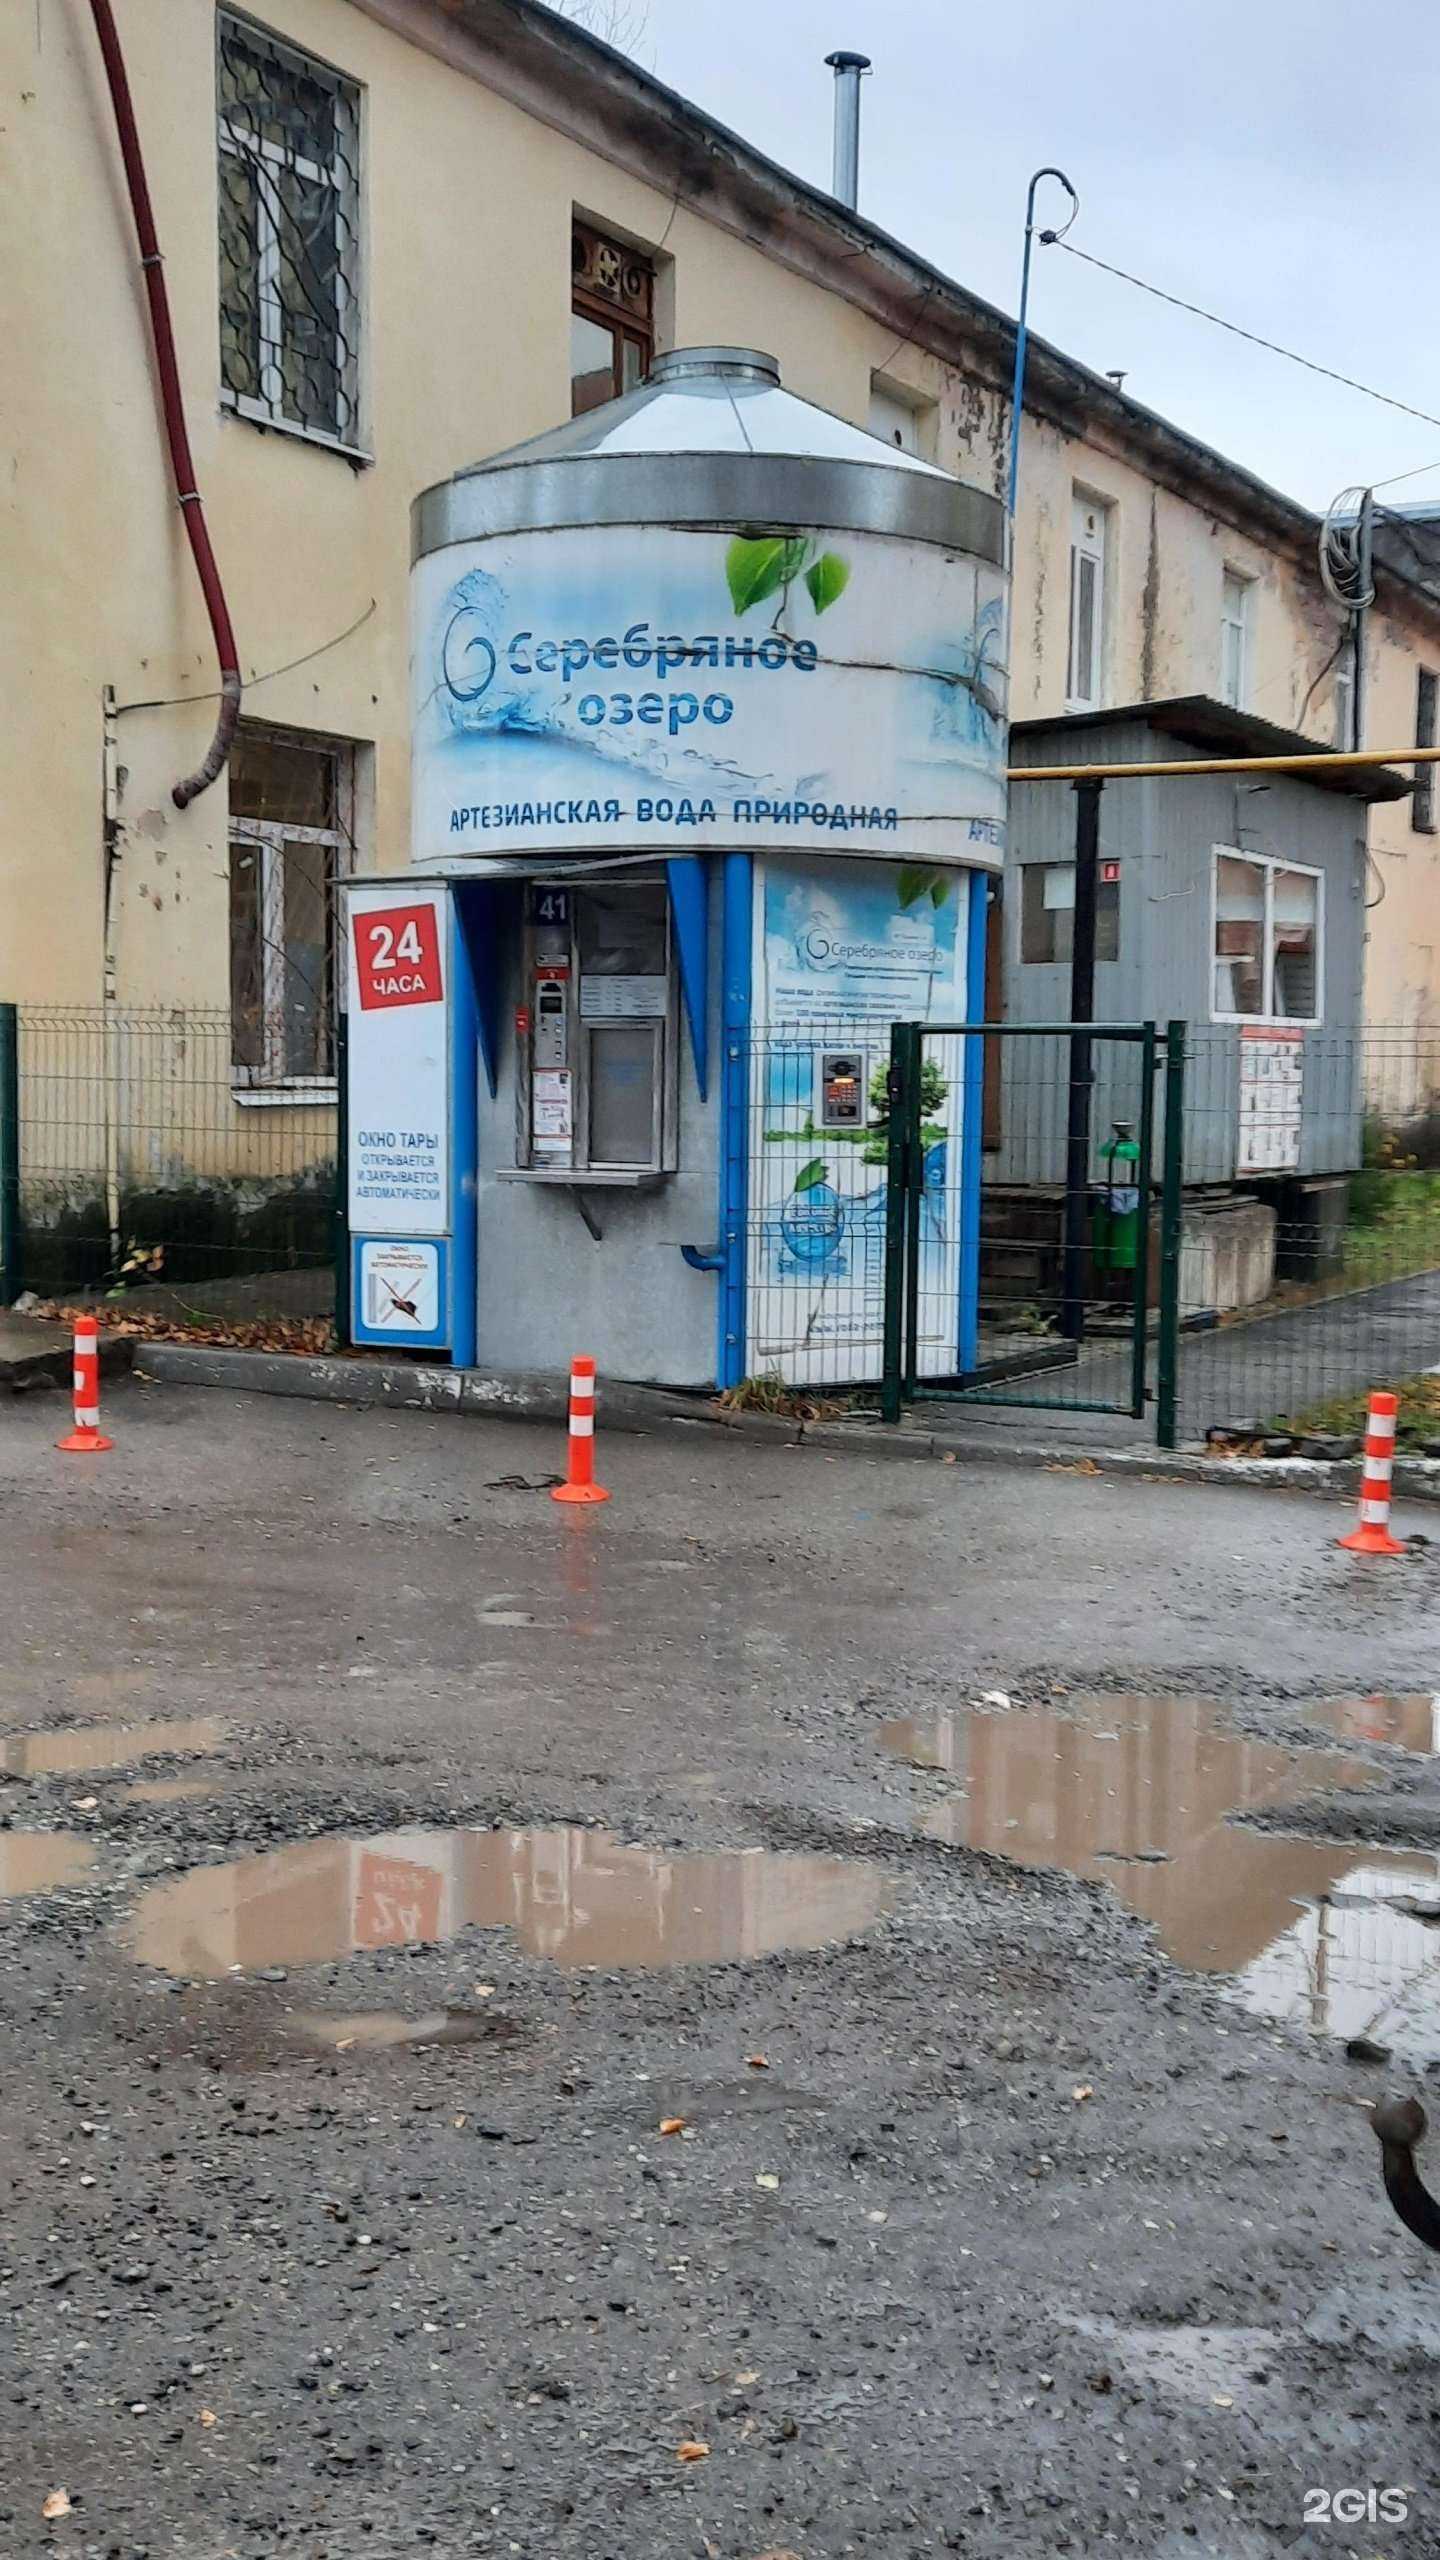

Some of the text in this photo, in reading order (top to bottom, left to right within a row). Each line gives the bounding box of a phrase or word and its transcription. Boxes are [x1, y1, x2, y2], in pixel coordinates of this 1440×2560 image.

[508, 623, 818, 682] Серебряное
[577, 692, 734, 735] озеро
[450, 799, 897, 832] АРТЕЗИАНСКАЯ ВОДА ПРИРОДНАЯ
[539, 894, 567, 920] 41
[369, 920, 424, 970] 24
[372, 973, 426, 995] ЧАСА
[358, 1131, 439, 1149] ОКНО ТАРЫ
[361, 1153, 435, 1166] ОТКРЫВАЕТСЯ
[357, 1170, 440, 1184] И ЗАКРЫВАЕТСЯ
[356, 1186, 441, 1200] АВТОМАТИЧЕСКИ
